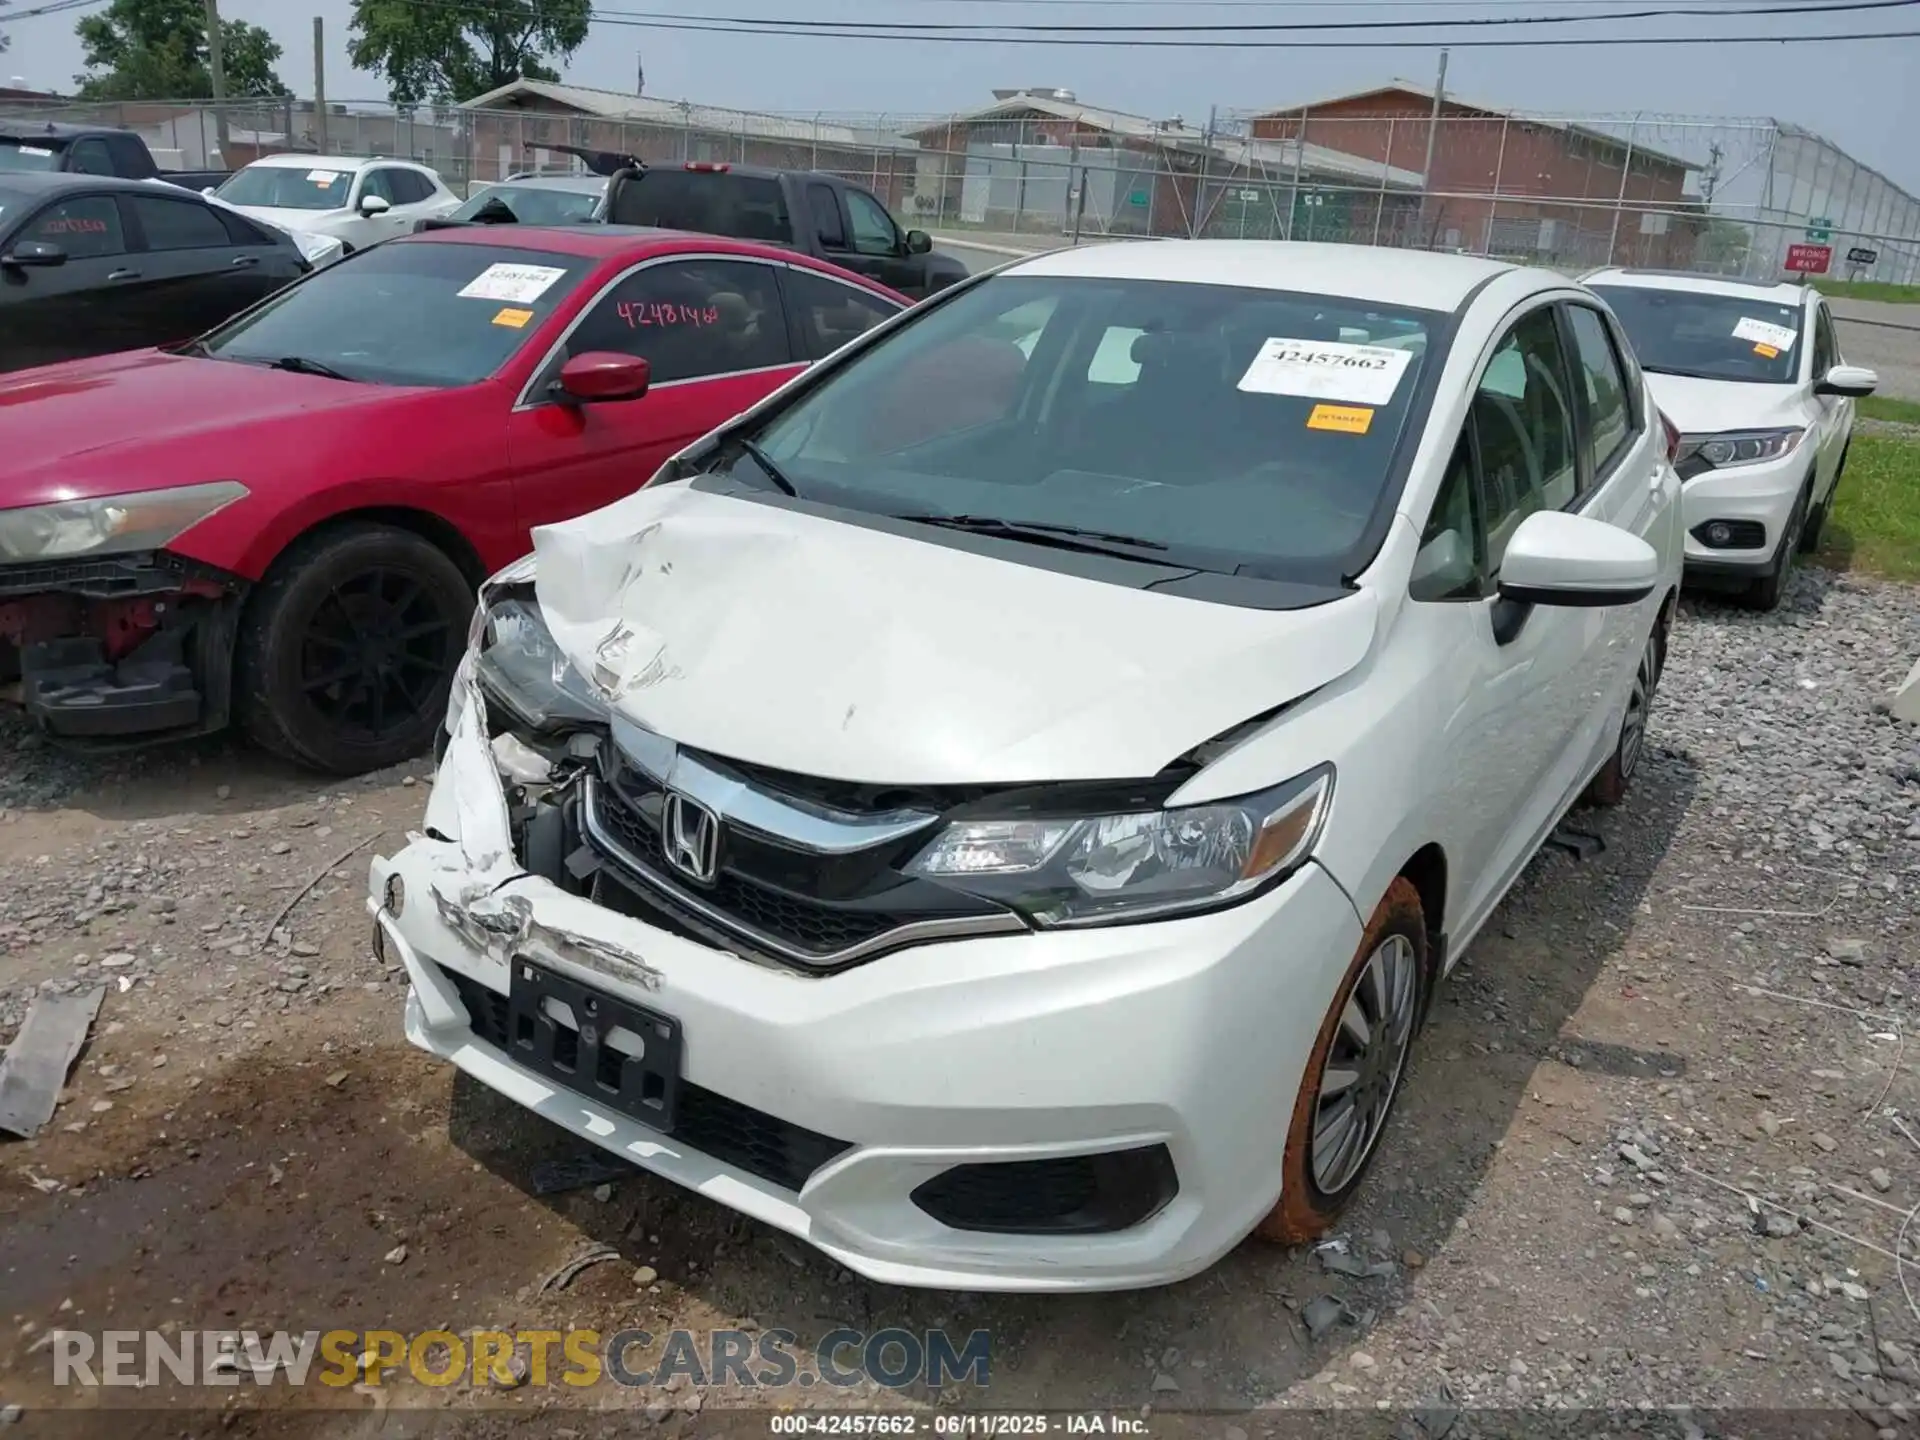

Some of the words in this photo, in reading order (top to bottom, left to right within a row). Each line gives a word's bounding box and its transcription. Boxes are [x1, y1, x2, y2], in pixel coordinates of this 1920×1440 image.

[1792, 247, 1828, 259] WRONG
[1796, 259, 1818, 269] WAY
[1272, 350, 1387, 370] 42457662
